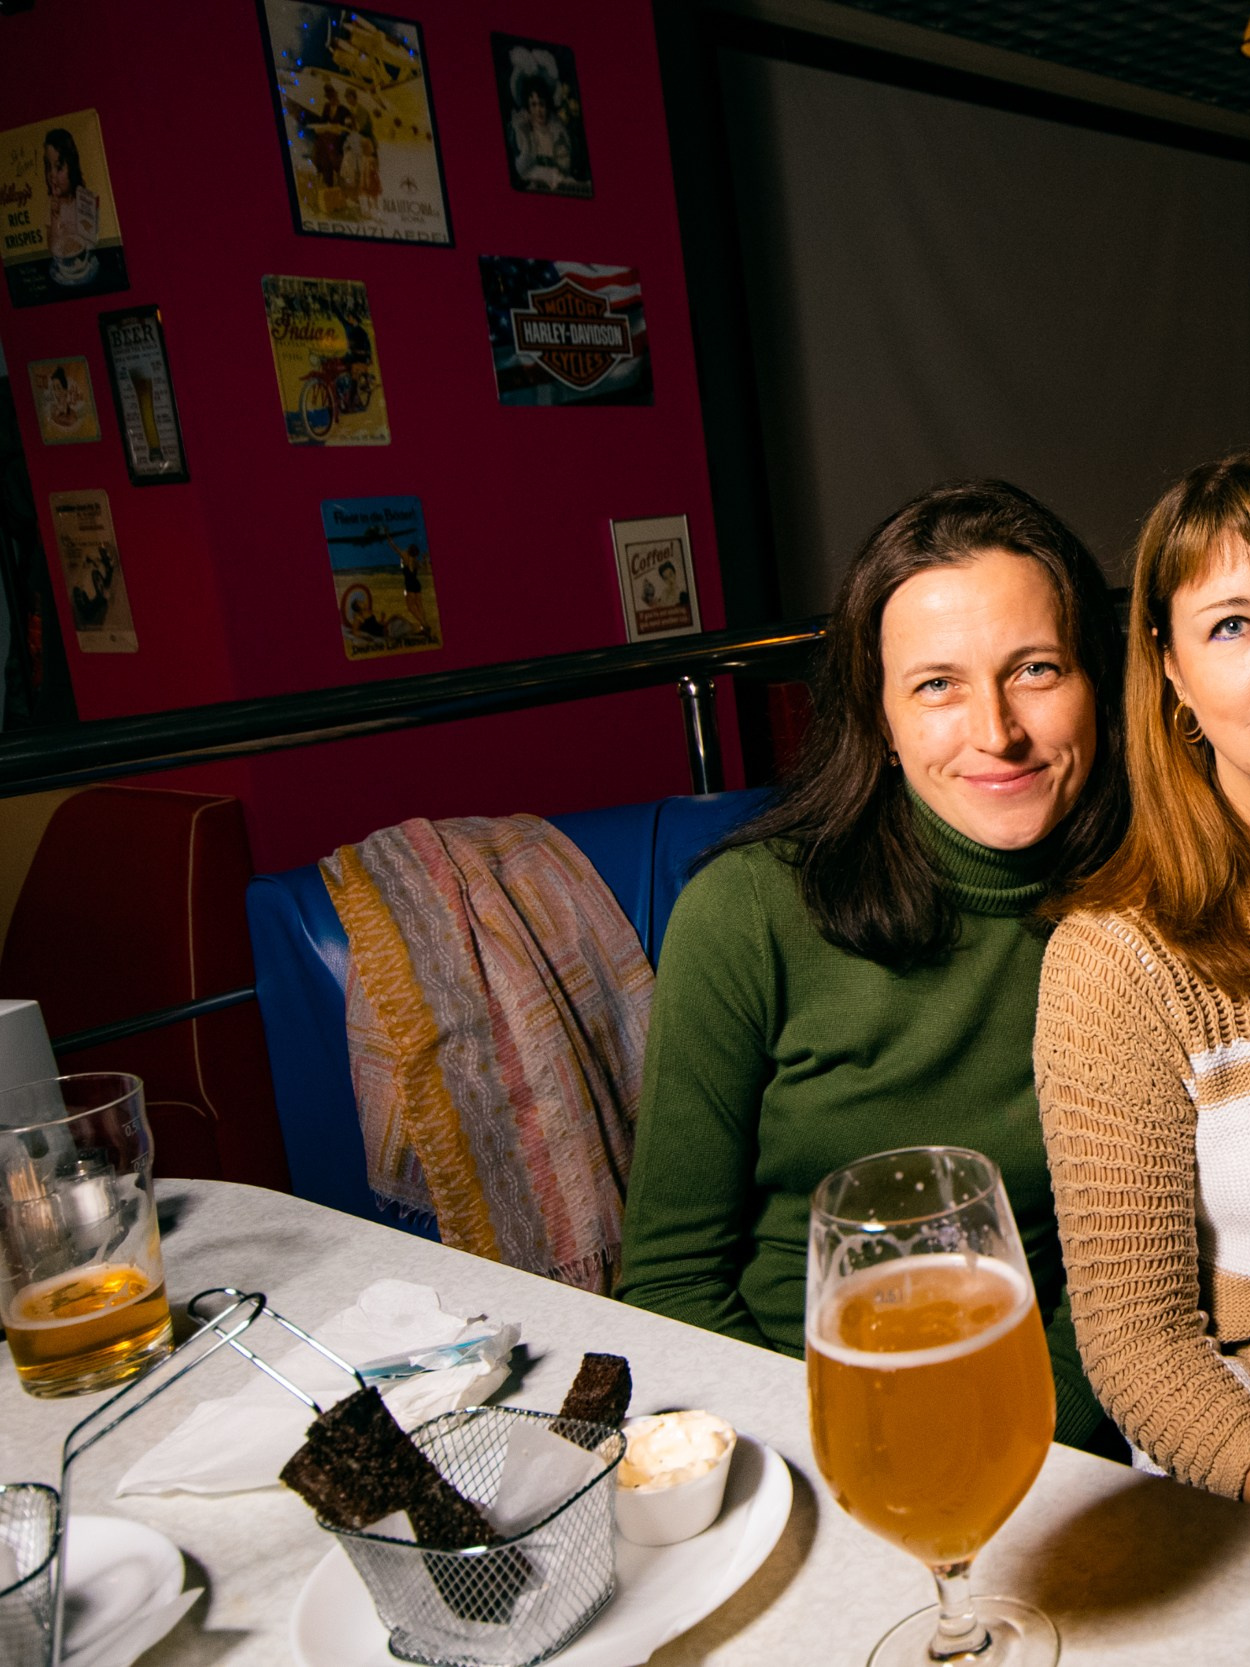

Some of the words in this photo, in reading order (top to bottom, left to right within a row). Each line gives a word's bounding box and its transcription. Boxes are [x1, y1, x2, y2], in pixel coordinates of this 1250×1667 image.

[8, 210, 31, 228] RICE
[5, 229, 43, 249] KRISPIES
[544, 292, 597, 316] MOTOR
[111, 324, 156, 348] BEER
[271, 307, 336, 340] Indian
[522, 320, 624, 347] HARLEY-DAVIDSON
[551, 351, 604, 378] CYCLES
[631, 541, 674, 575] Coffee!
